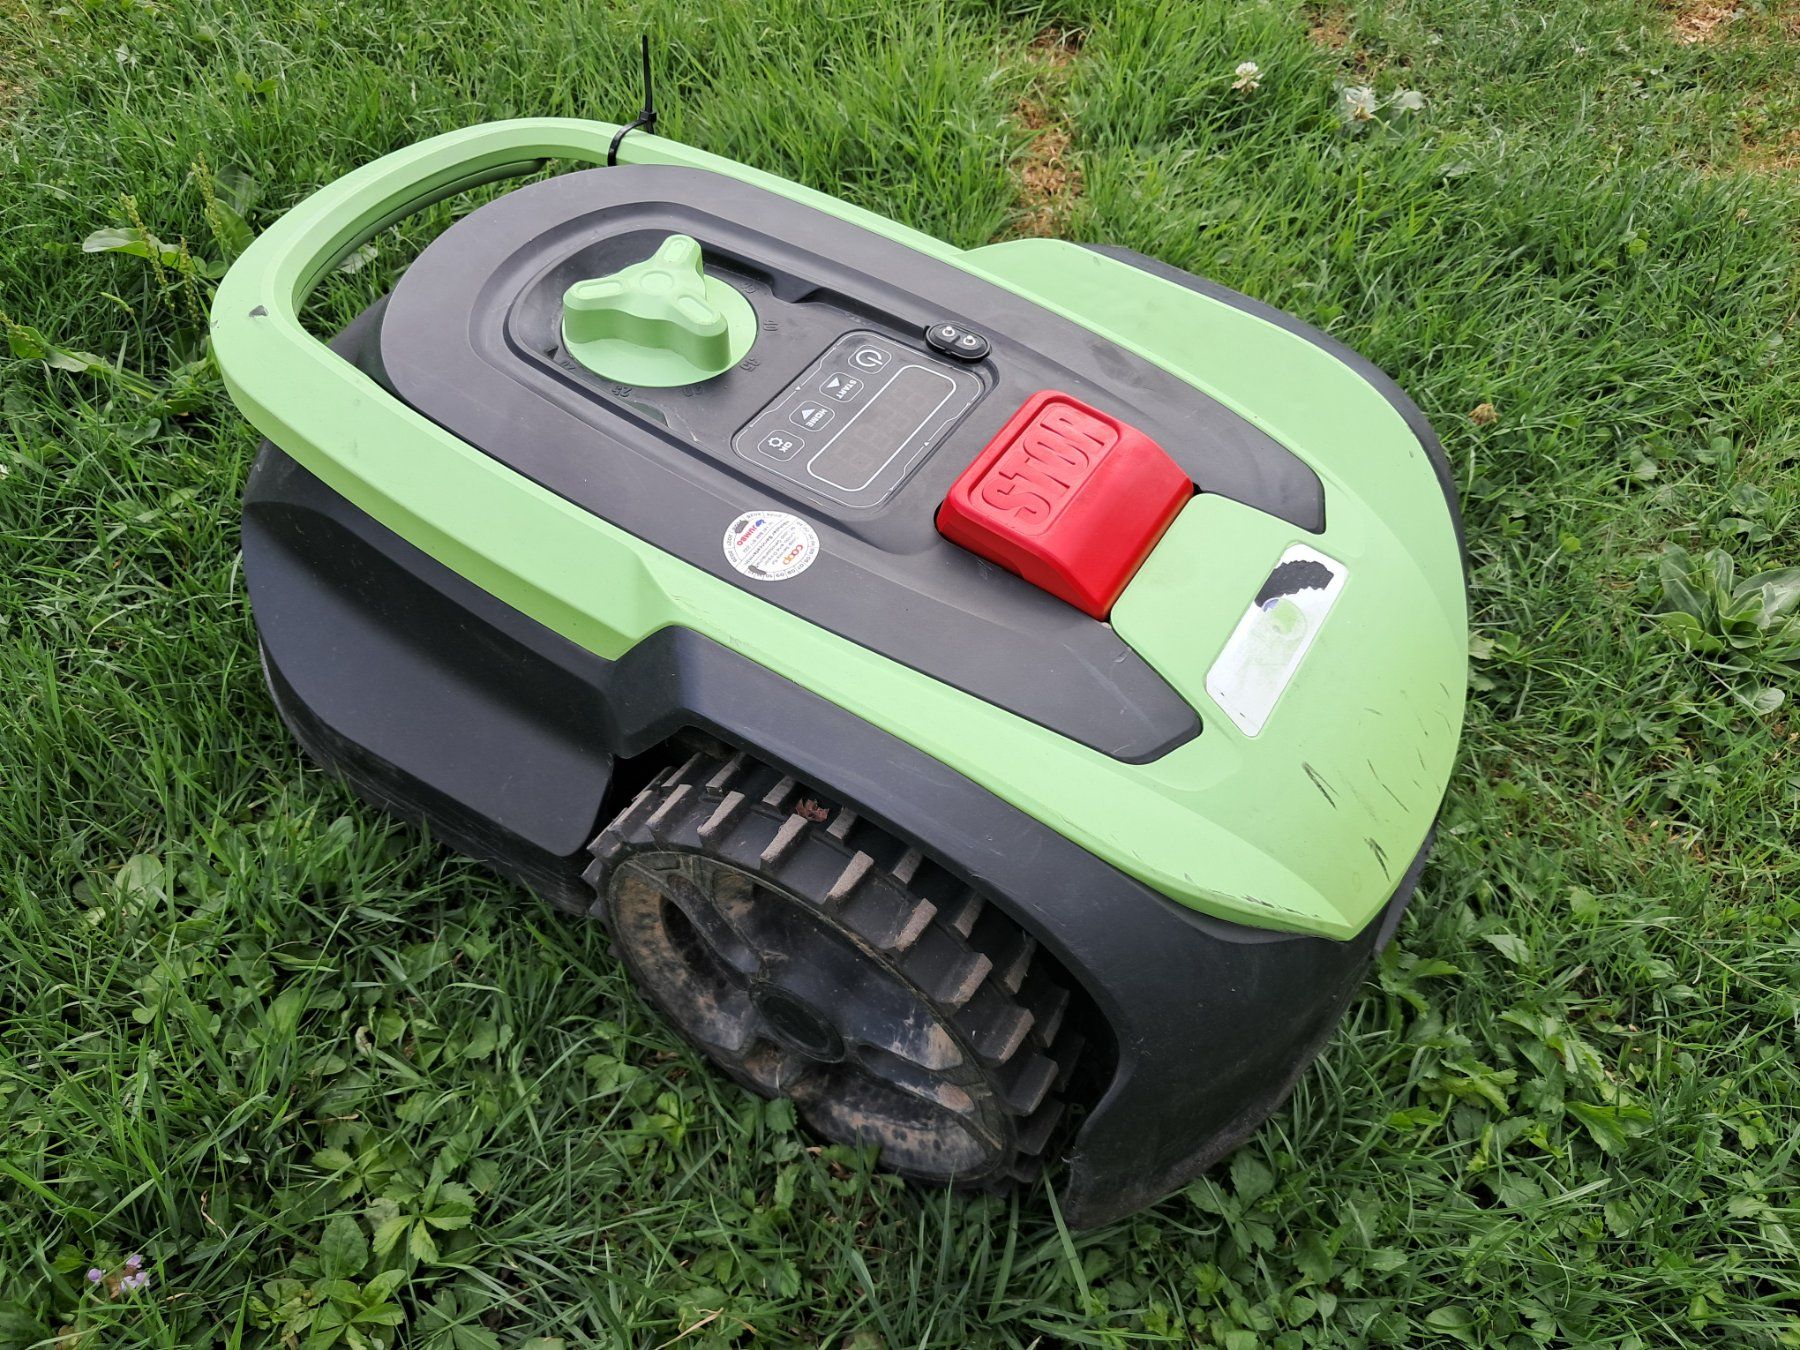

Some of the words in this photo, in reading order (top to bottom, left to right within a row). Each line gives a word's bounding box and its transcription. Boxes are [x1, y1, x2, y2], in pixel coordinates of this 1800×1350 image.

[611, 385, 633, 398] 25
[835, 379, 857, 400] START
[806, 408, 828, 428] HOME
[778, 440, 794, 453] OK
[981, 404, 1105, 525] STOP
[736, 524, 757, 546] JUMBO
